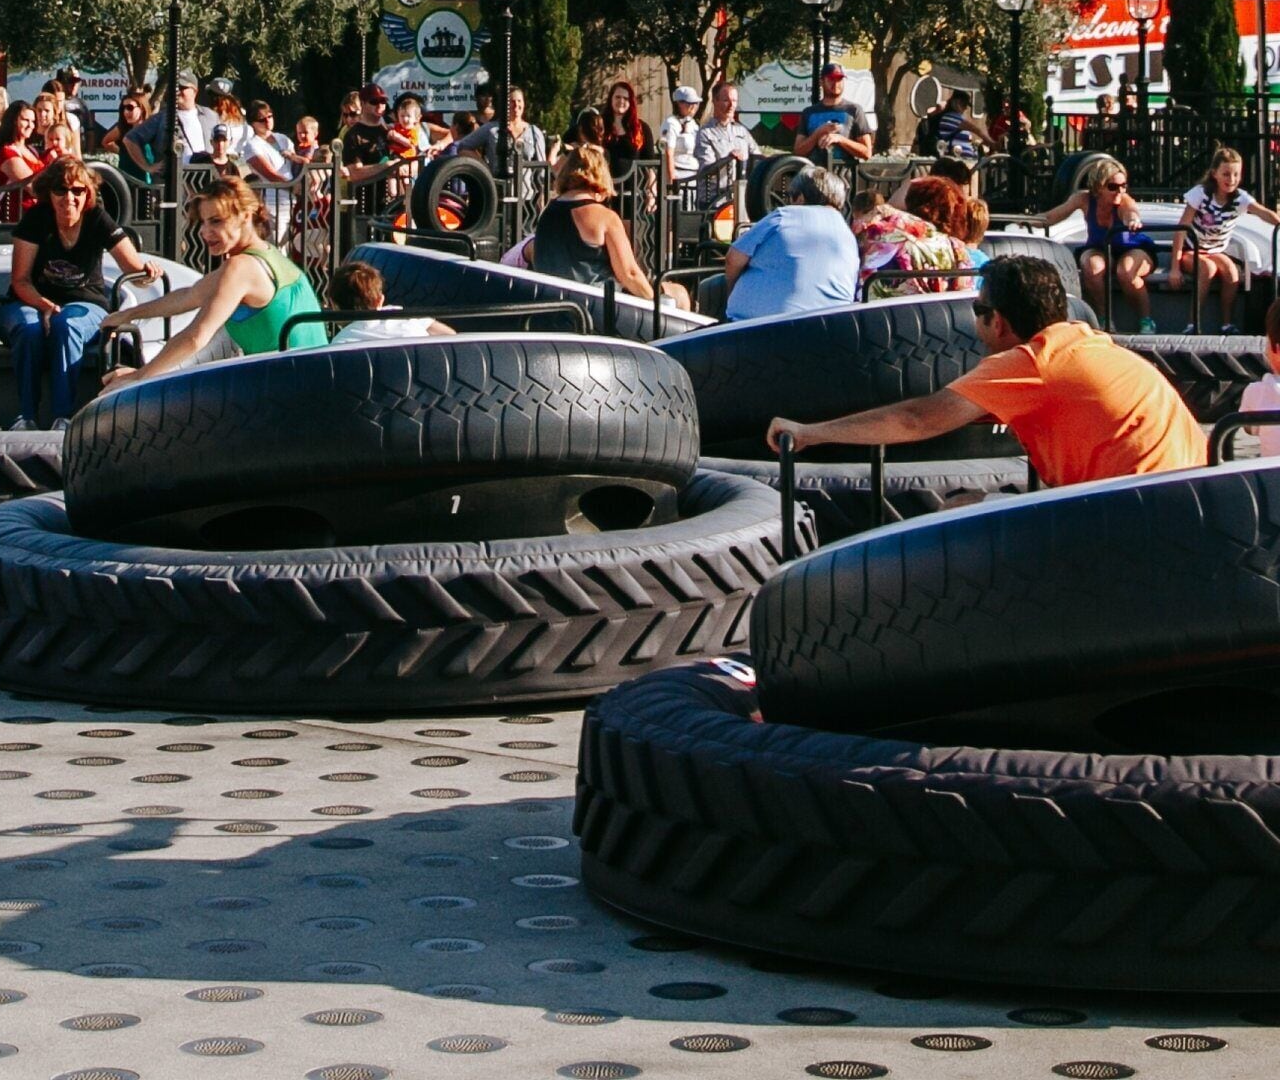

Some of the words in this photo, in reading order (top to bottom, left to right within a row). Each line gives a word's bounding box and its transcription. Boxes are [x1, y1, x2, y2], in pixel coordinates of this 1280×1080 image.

[80, 78, 129, 88] AIRBORN
[401, 80, 425, 90] LEAN
[773, 83, 789, 92] Seat
[791, 83, 803, 92] the
[81, 91, 100, 101] lean
[103, 92, 117, 101] too
[757, 97, 796, 106] passenger
[451, 494, 461, 514] 1
